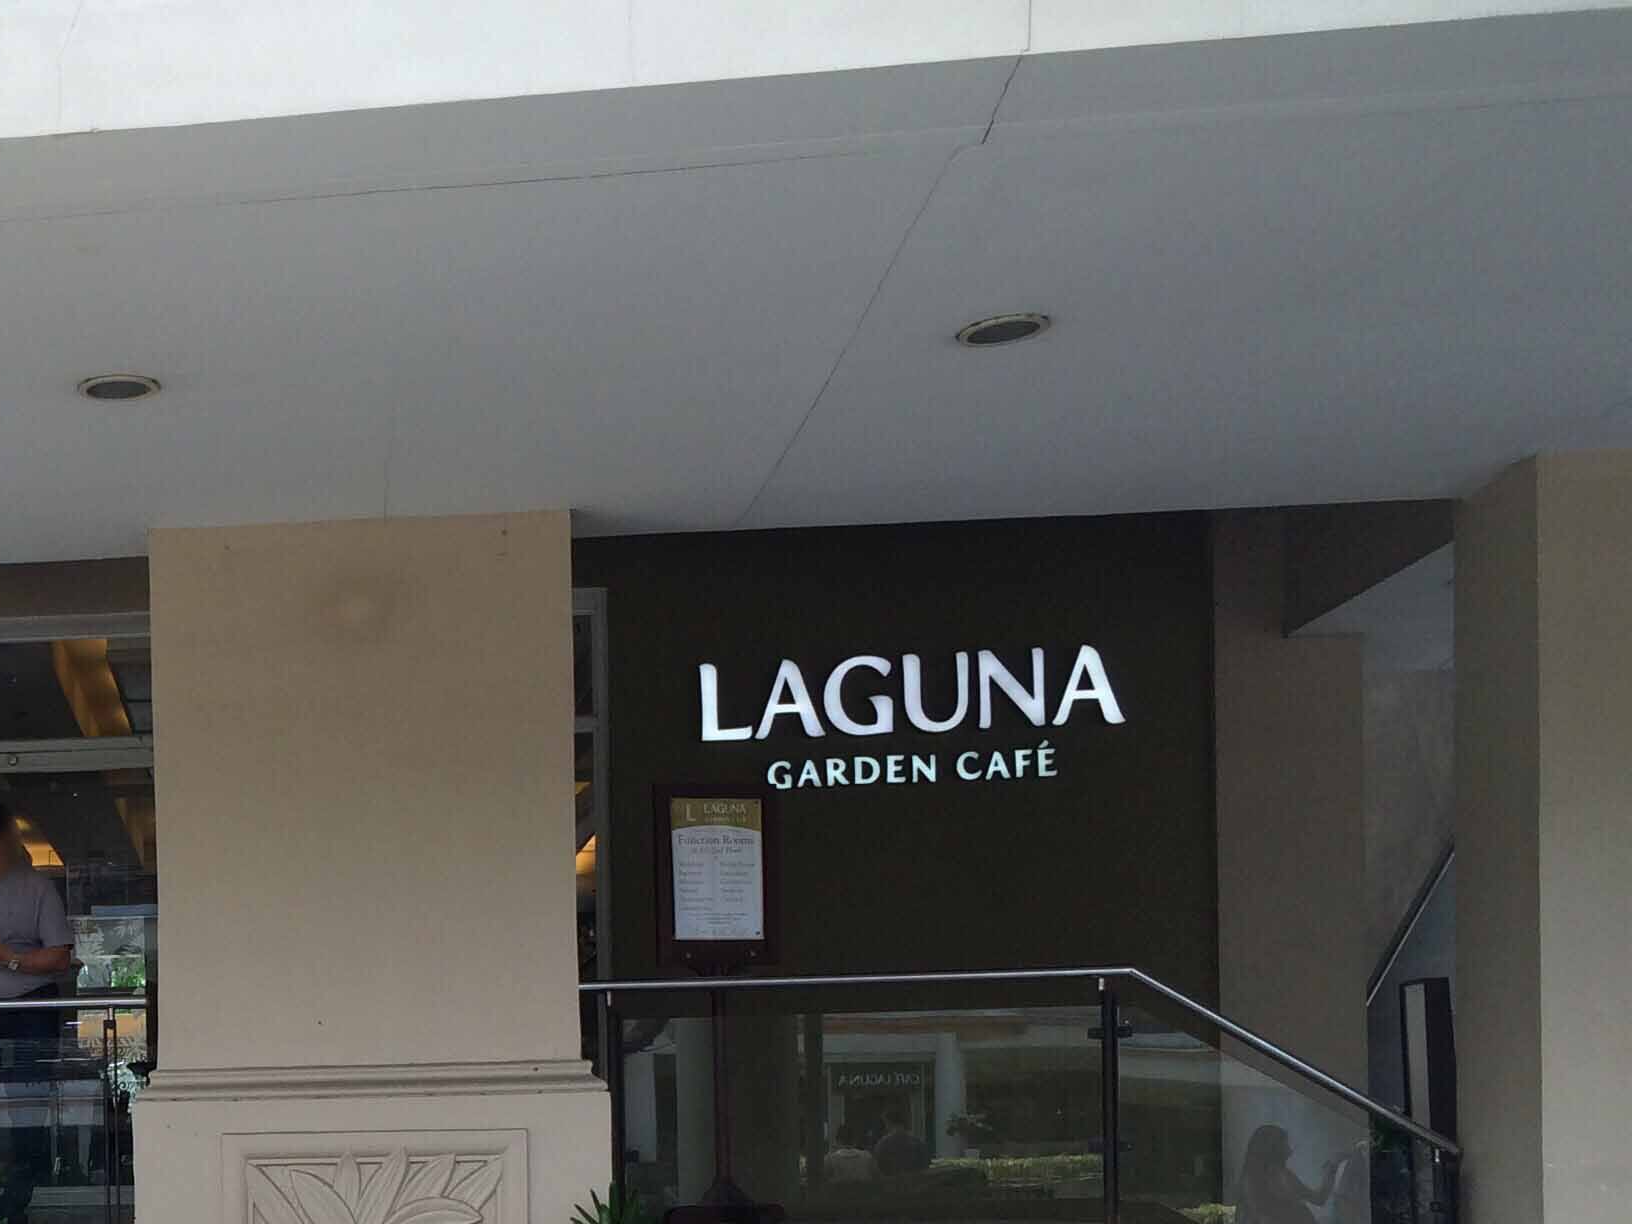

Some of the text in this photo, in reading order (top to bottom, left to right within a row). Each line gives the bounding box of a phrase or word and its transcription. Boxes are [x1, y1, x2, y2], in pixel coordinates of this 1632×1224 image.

[698, 644, 1126, 741] LAGUNA
[768, 740, 1058, 789] GARDEN CAFÉ
